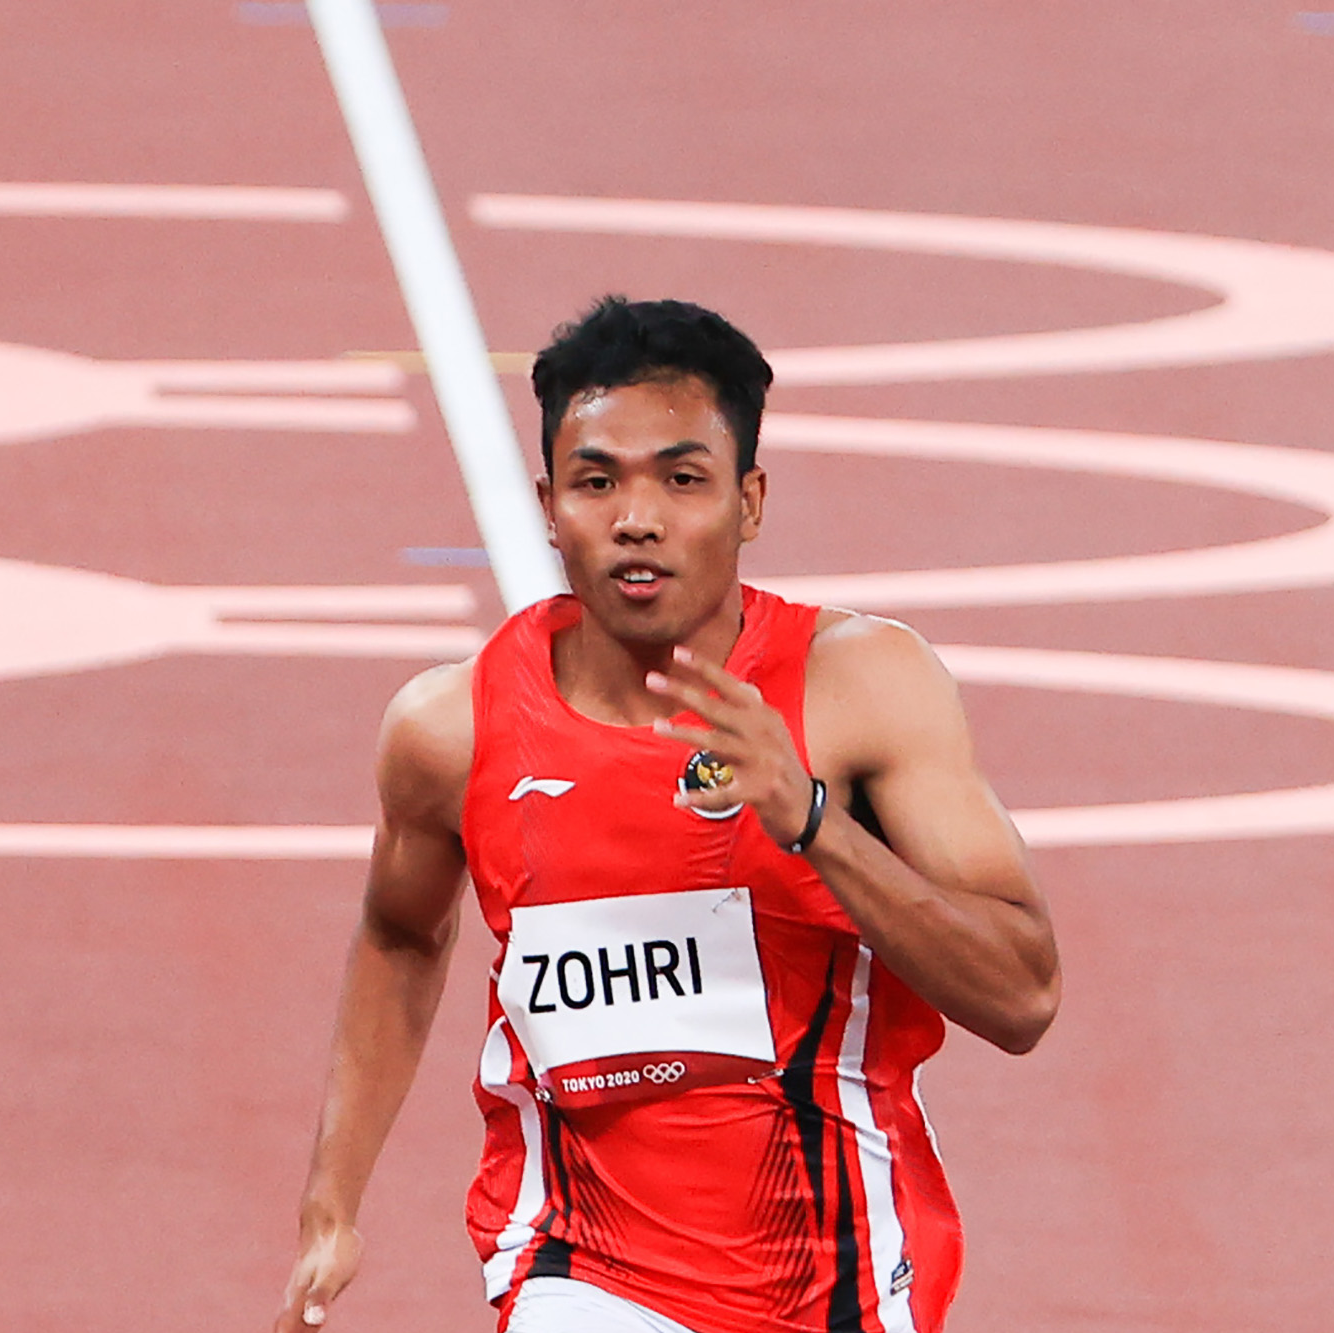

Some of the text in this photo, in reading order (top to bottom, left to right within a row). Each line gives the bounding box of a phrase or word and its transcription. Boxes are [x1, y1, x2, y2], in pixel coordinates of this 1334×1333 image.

[521, 937, 703, 1014] ZOHRI
[561, 1069, 641, 1093] TOKYO 2020
